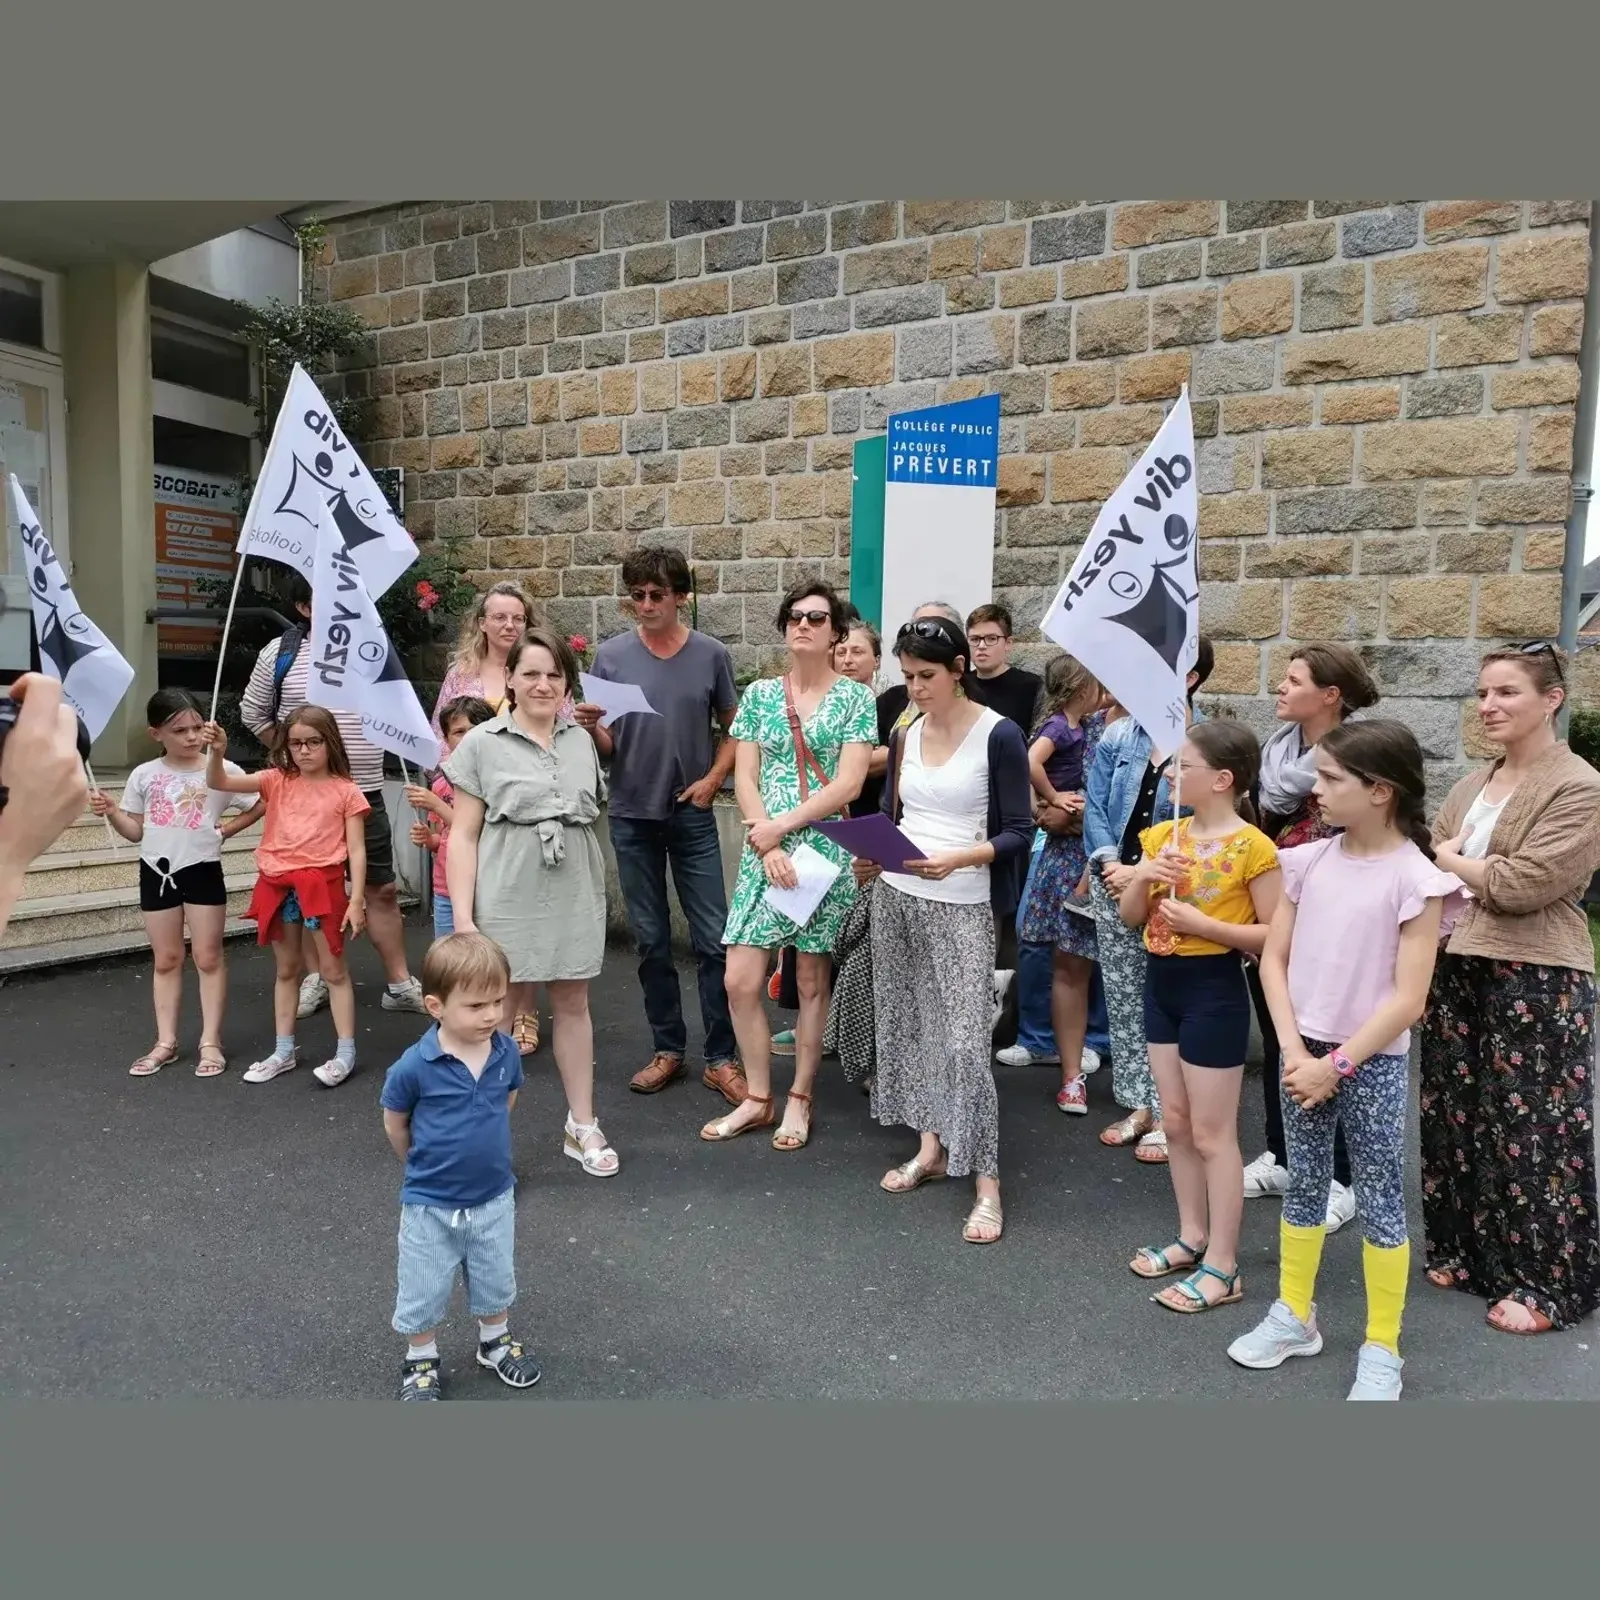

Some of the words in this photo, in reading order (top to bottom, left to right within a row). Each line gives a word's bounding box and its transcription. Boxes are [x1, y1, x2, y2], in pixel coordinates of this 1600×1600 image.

[303, 409, 347, 454] div
[894, 420, 945, 433] COLLÈGE
[951, 424, 993, 435] PUBLIC
[892, 441, 946, 453] JACQUES
[893, 452, 991, 476] PRÉVERT
